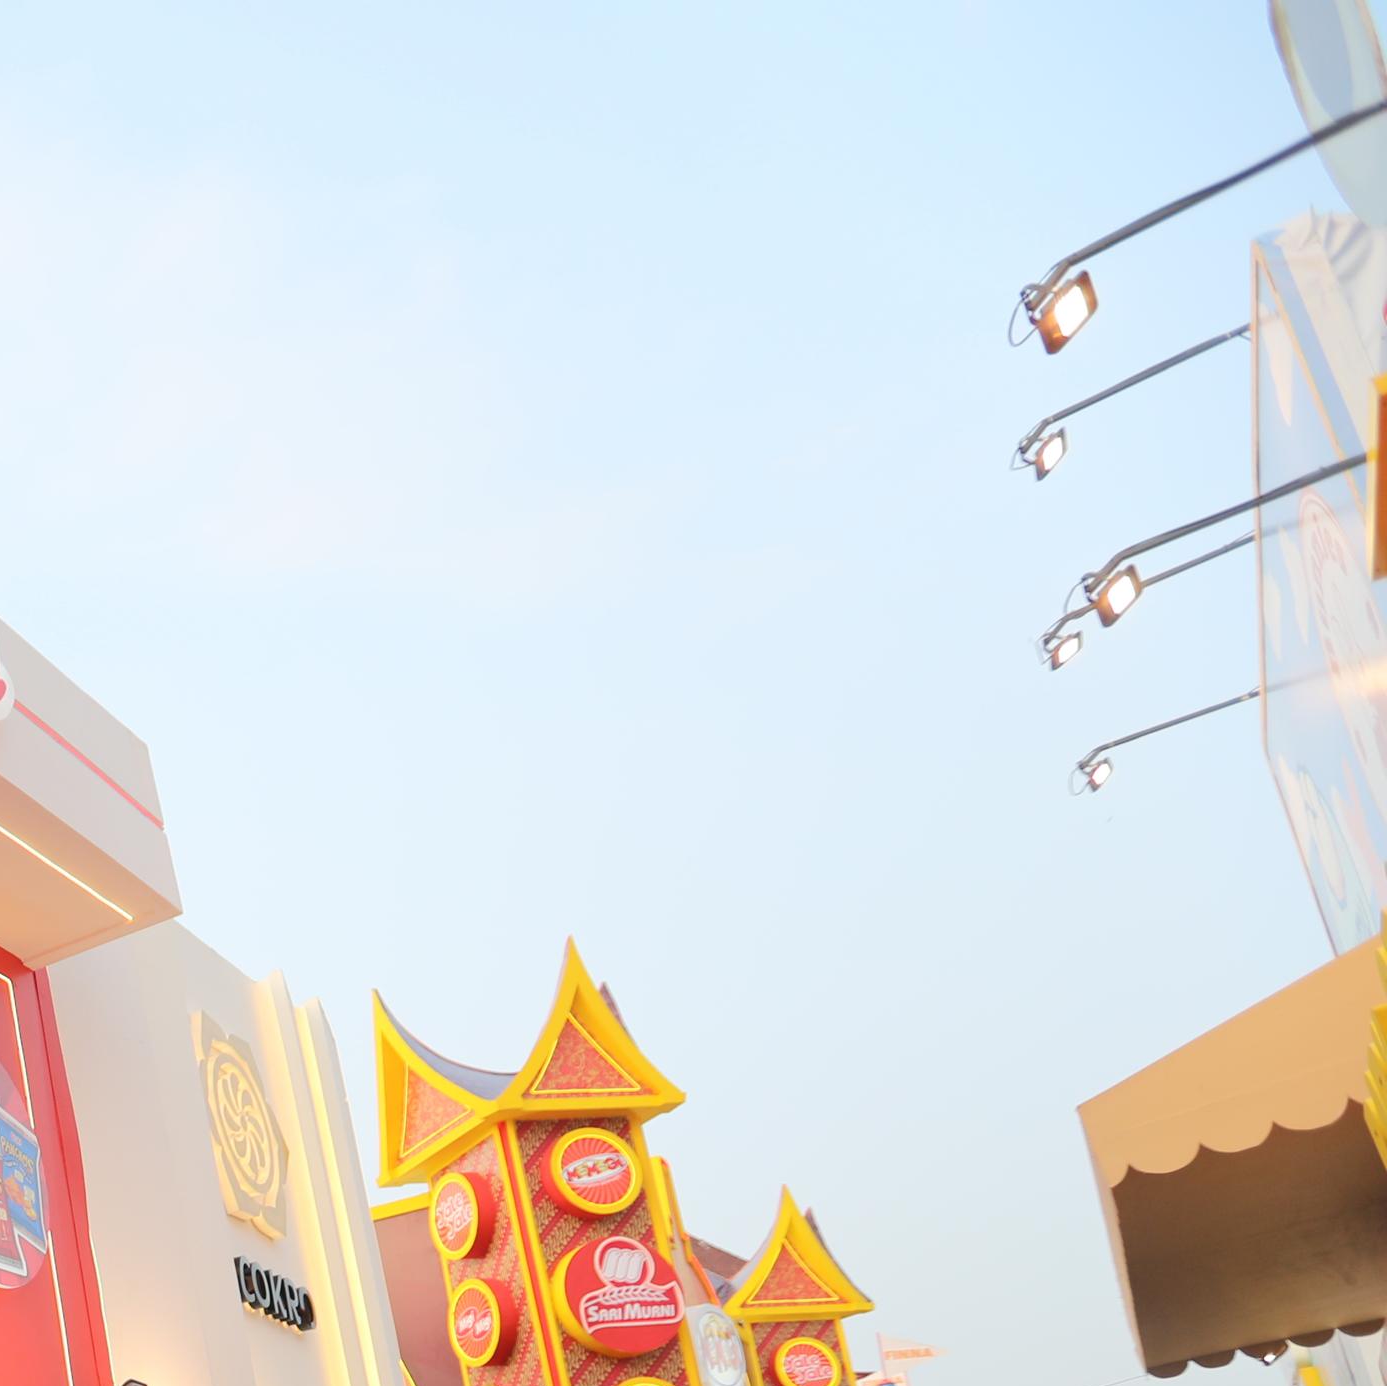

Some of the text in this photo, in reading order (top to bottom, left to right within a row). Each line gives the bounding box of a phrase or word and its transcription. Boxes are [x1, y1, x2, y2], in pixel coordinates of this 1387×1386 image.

[238, 1257, 315, 1330] COKRO
[587, 1303, 676, 1322] SARI MURNI
